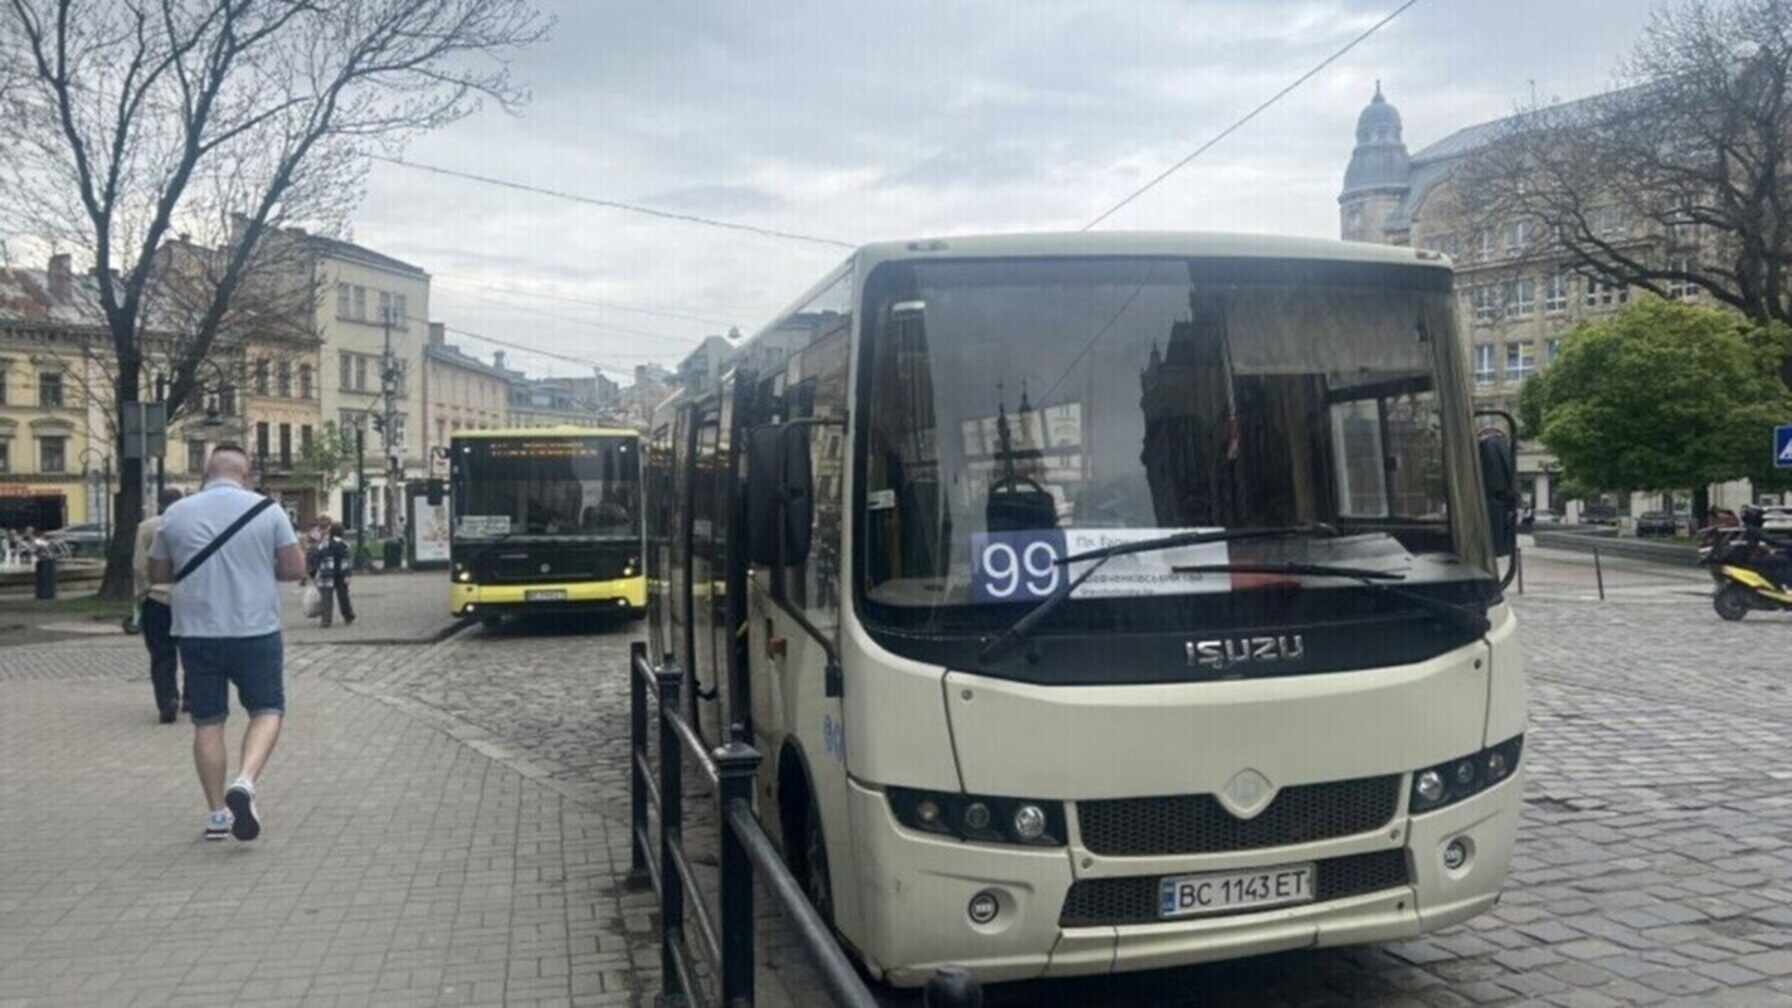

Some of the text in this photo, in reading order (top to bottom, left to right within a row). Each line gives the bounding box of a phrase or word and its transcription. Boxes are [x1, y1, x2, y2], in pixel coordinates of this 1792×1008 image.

[982, 540, 1060, 598] 99
[1185, 634, 1304, 665] ISUZU
[1180, 872, 1306, 907] BC 1143 ET
